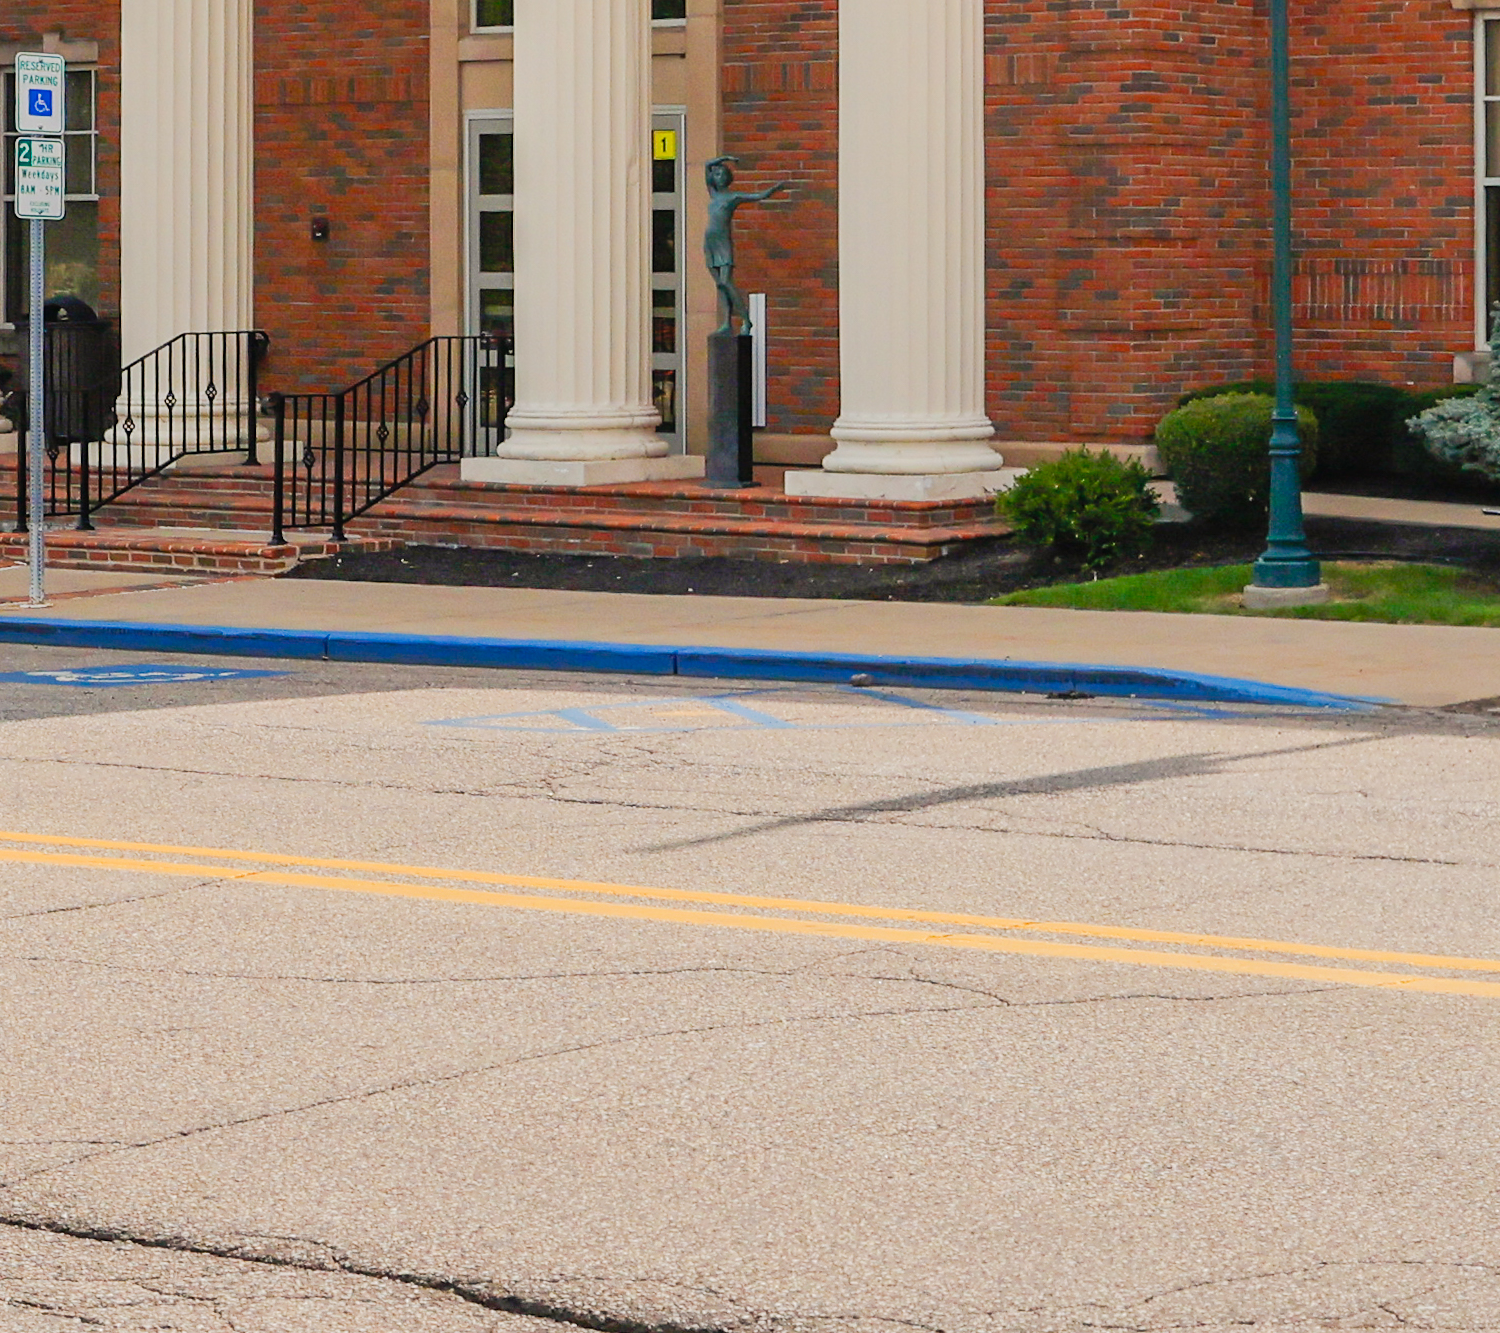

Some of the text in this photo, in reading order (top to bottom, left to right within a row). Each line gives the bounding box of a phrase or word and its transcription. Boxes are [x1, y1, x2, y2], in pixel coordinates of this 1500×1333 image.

[20, 60, 61, 73] RESERVED
[22, 74, 58, 86] PARKING
[661, 137, 666, 152] 1
[19, 143, 53, 162] 2 HR
[32, 156, 61, 166] PARKING
[22, 169, 59, 182] Weekdays
[45, 185, 59, 195] 5PM
